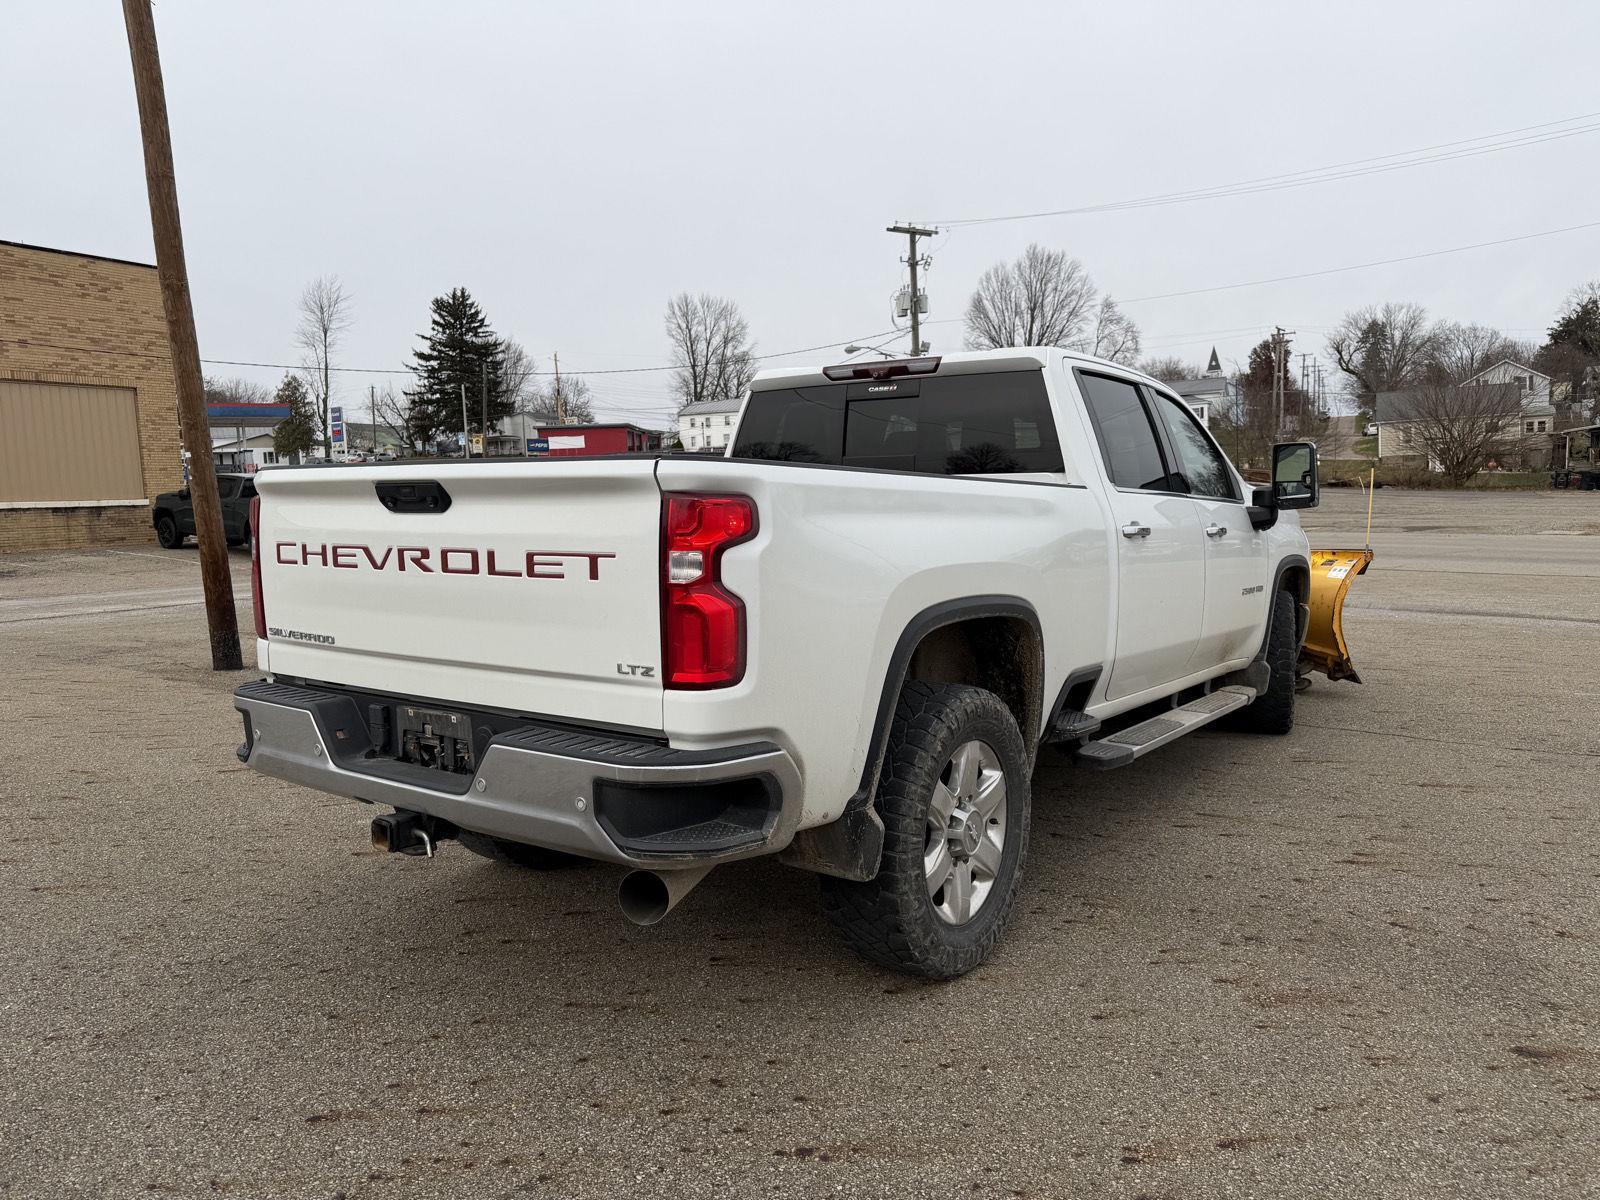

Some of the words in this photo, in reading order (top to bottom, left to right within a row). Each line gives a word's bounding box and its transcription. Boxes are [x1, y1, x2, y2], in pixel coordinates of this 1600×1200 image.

[275, 541, 617, 581] CHEVROLET
[268, 627, 336, 645] SILVERADO
[616, 663, 655, 678] LTZ
